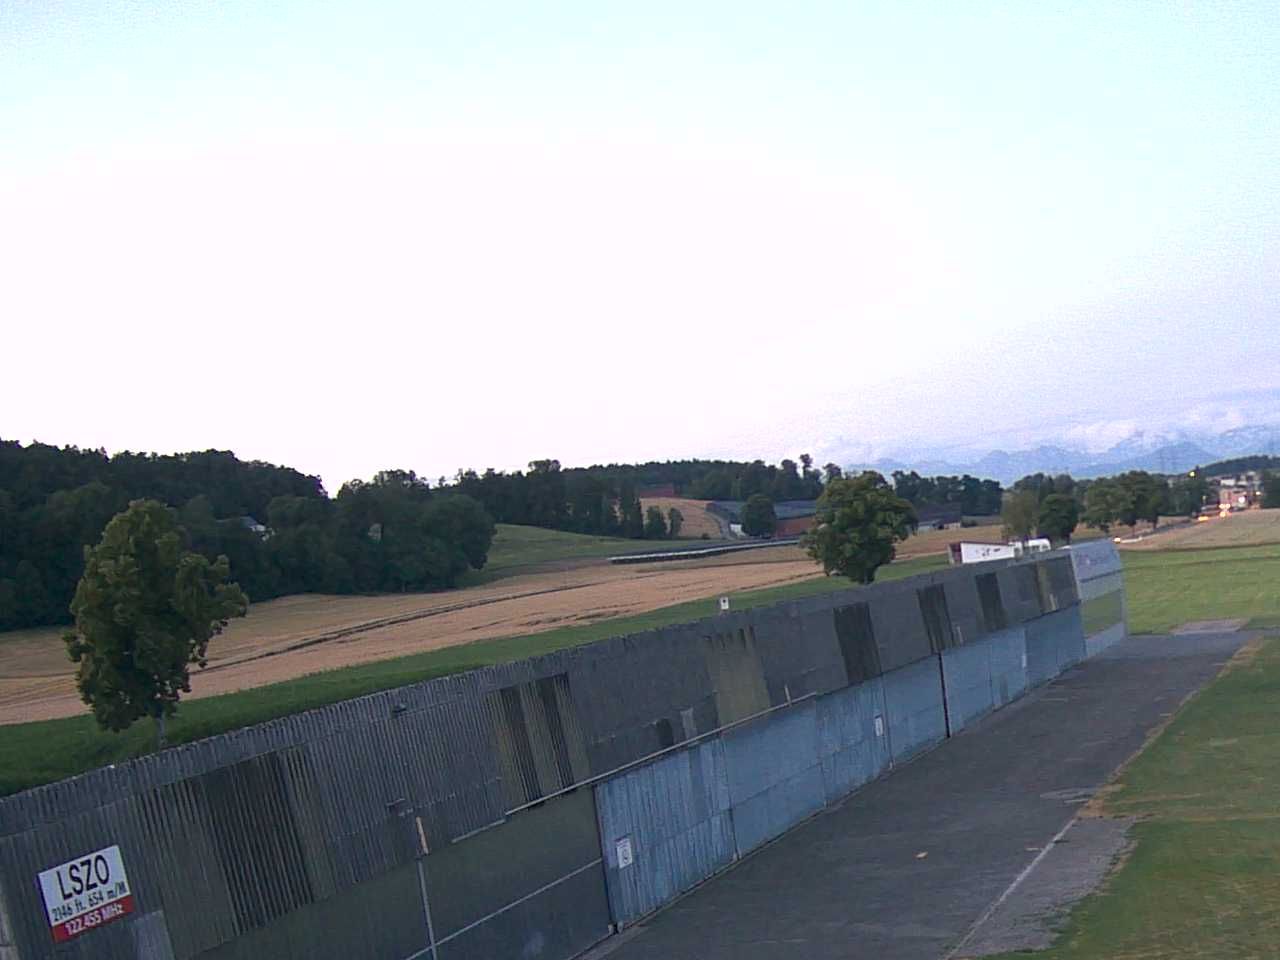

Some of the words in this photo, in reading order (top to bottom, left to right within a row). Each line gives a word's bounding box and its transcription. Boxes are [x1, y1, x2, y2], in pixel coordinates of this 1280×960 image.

[56, 854, 109, 901] LSZO
[87, 890, 104, 908] 654
[101, 903, 124, 921] MHz
